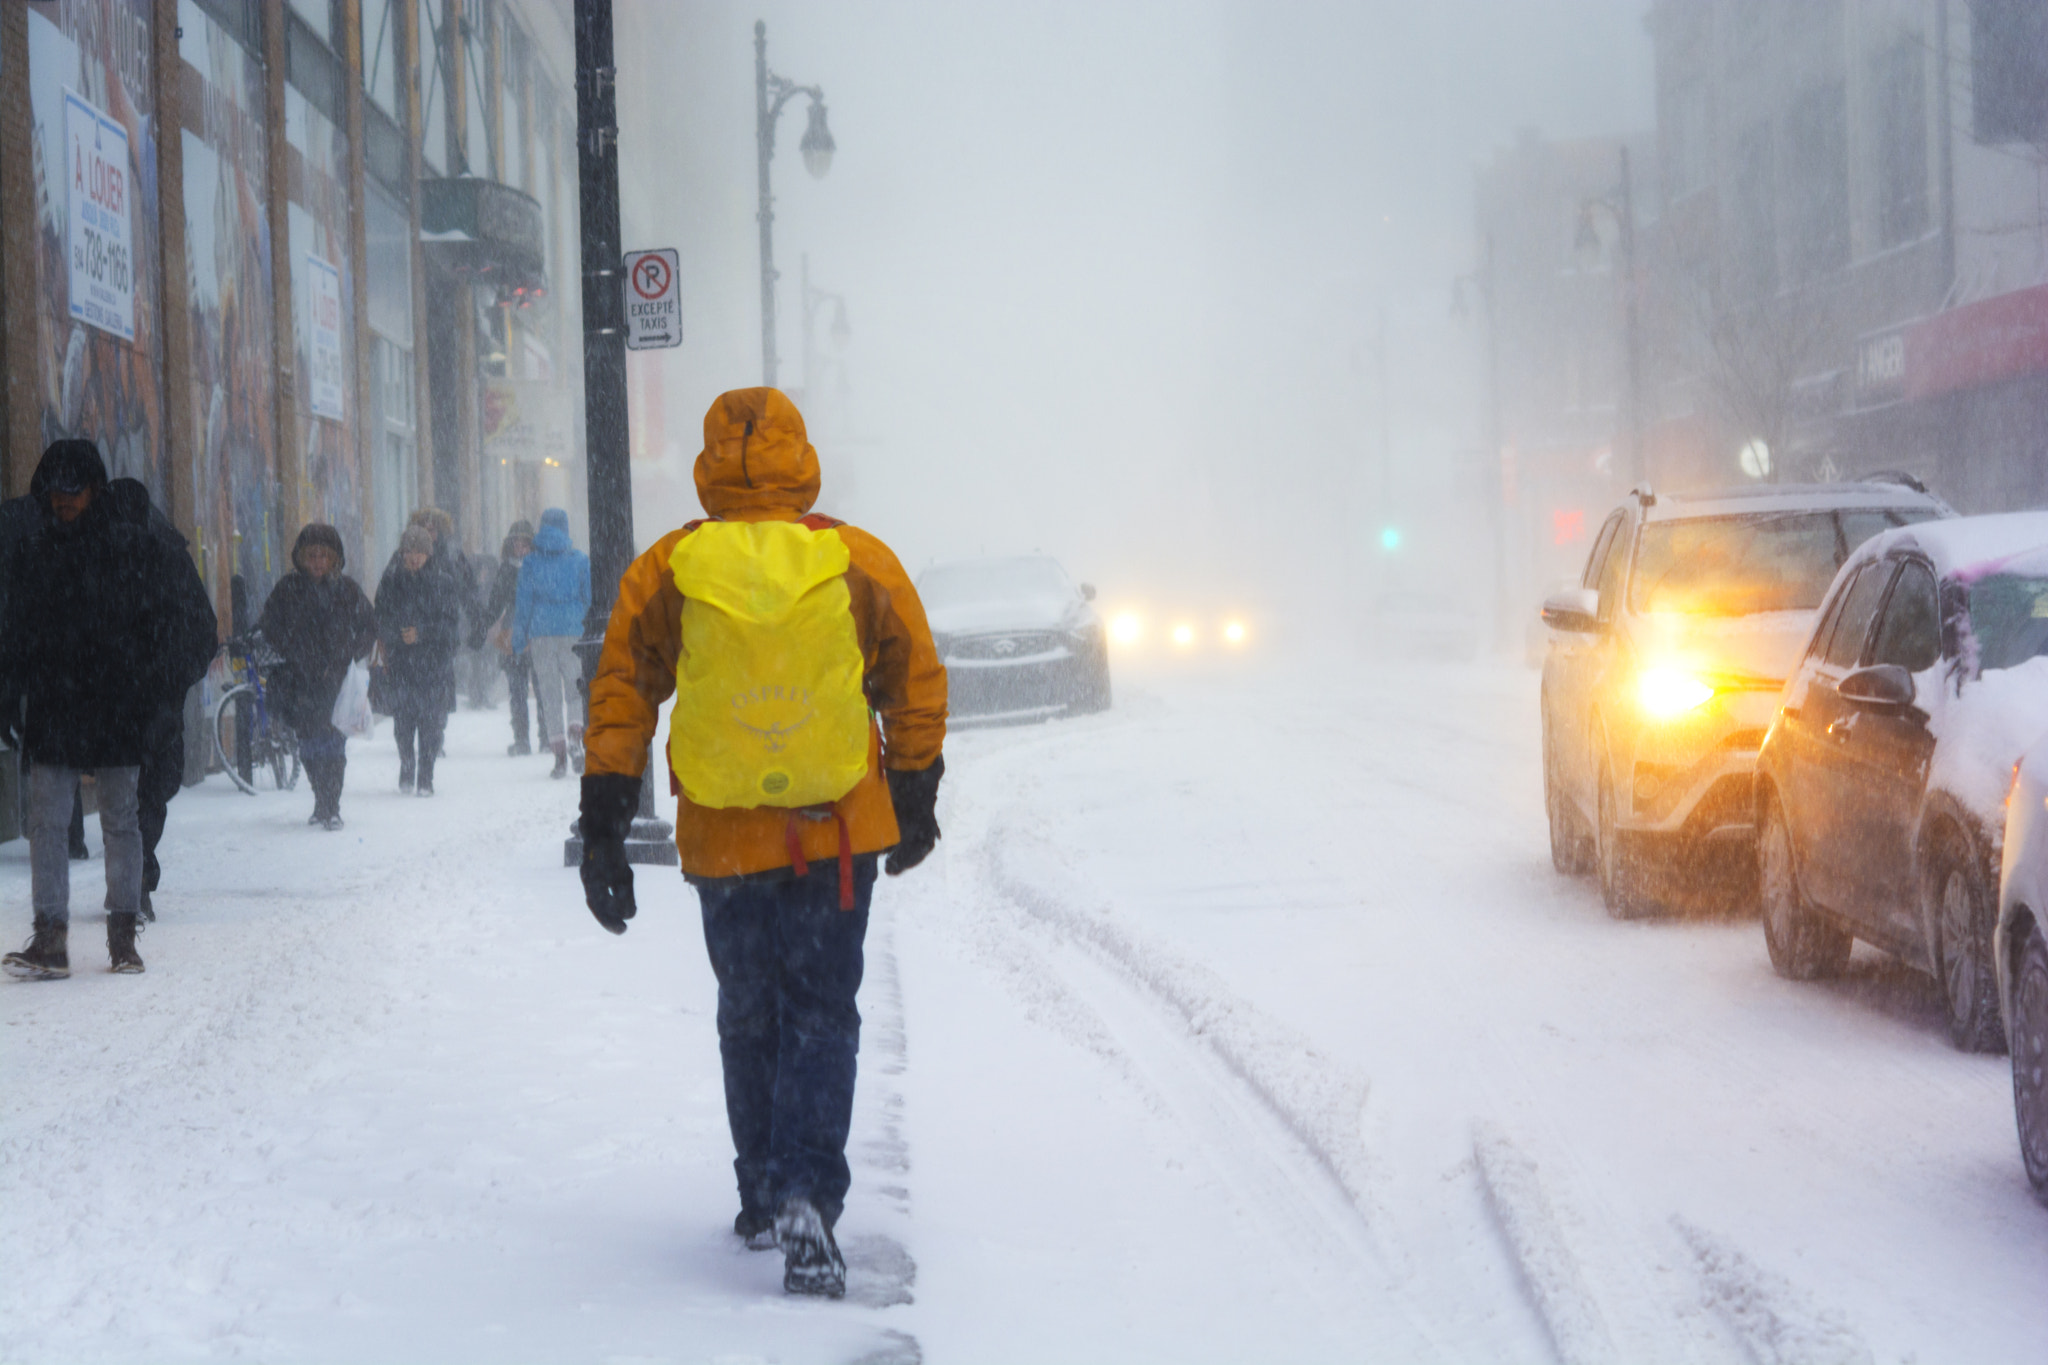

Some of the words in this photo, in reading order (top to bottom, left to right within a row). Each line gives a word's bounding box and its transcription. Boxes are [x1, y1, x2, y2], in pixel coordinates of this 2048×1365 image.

[75, 132, 84, 192] À
[88, 151, 124, 217] LOUER
[84, 227, 128, 294] 738-1166
[631, 299, 674, 317] EXCEPTÉ
[640, 316, 668, 331] TAXIS
[731, 685, 814, 710] OSPREY
